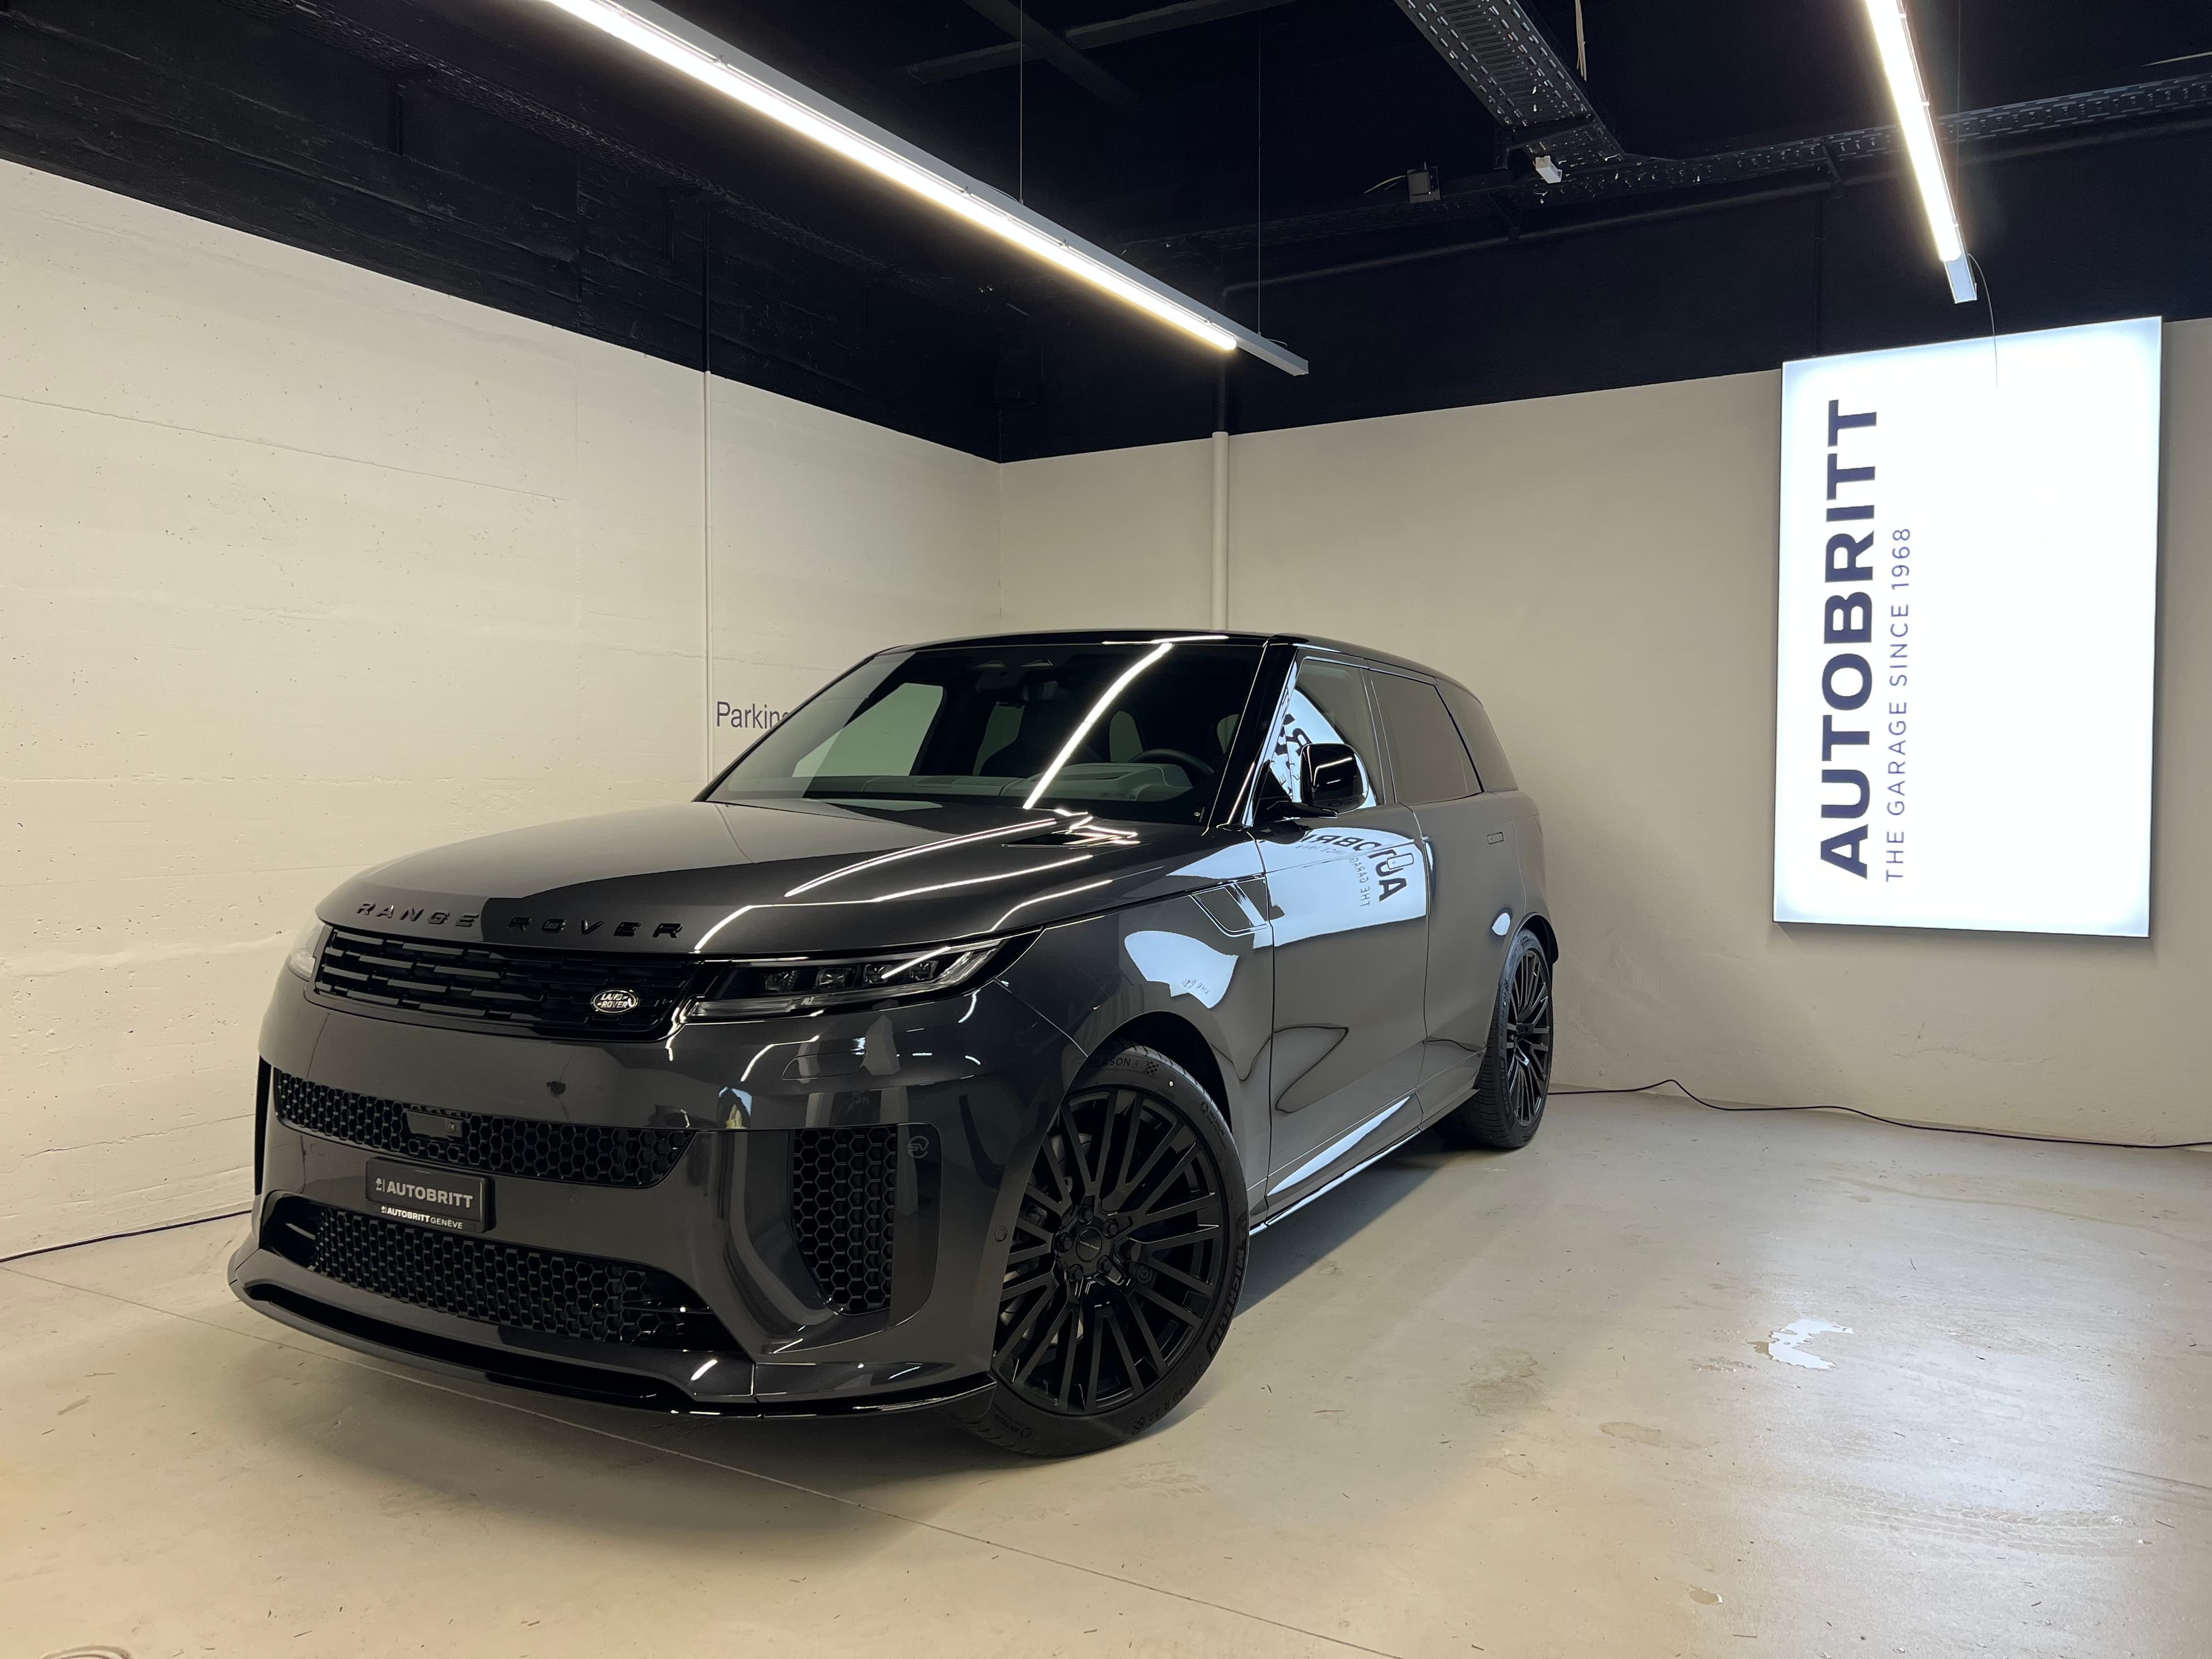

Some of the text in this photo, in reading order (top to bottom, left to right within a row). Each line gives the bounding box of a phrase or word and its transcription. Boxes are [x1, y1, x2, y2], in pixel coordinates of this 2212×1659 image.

[1820, 399, 1877, 880] AUTOBRITT
[717, 700, 790, 729] Parkin
[1885, 528, 1911, 882] THE GARAGE SINCE 1968
[355, 902, 684, 940] RANGE ROVER
[600, 993, 623, 1001] LAND
[600, 1001, 628, 1009] ROVER
[387, 1181, 474, 1209] AUTOBRITT
[387, 1207, 431, 1223] AUTOBRITT
[1209, 1247, 1245, 1353] MICHELIN
